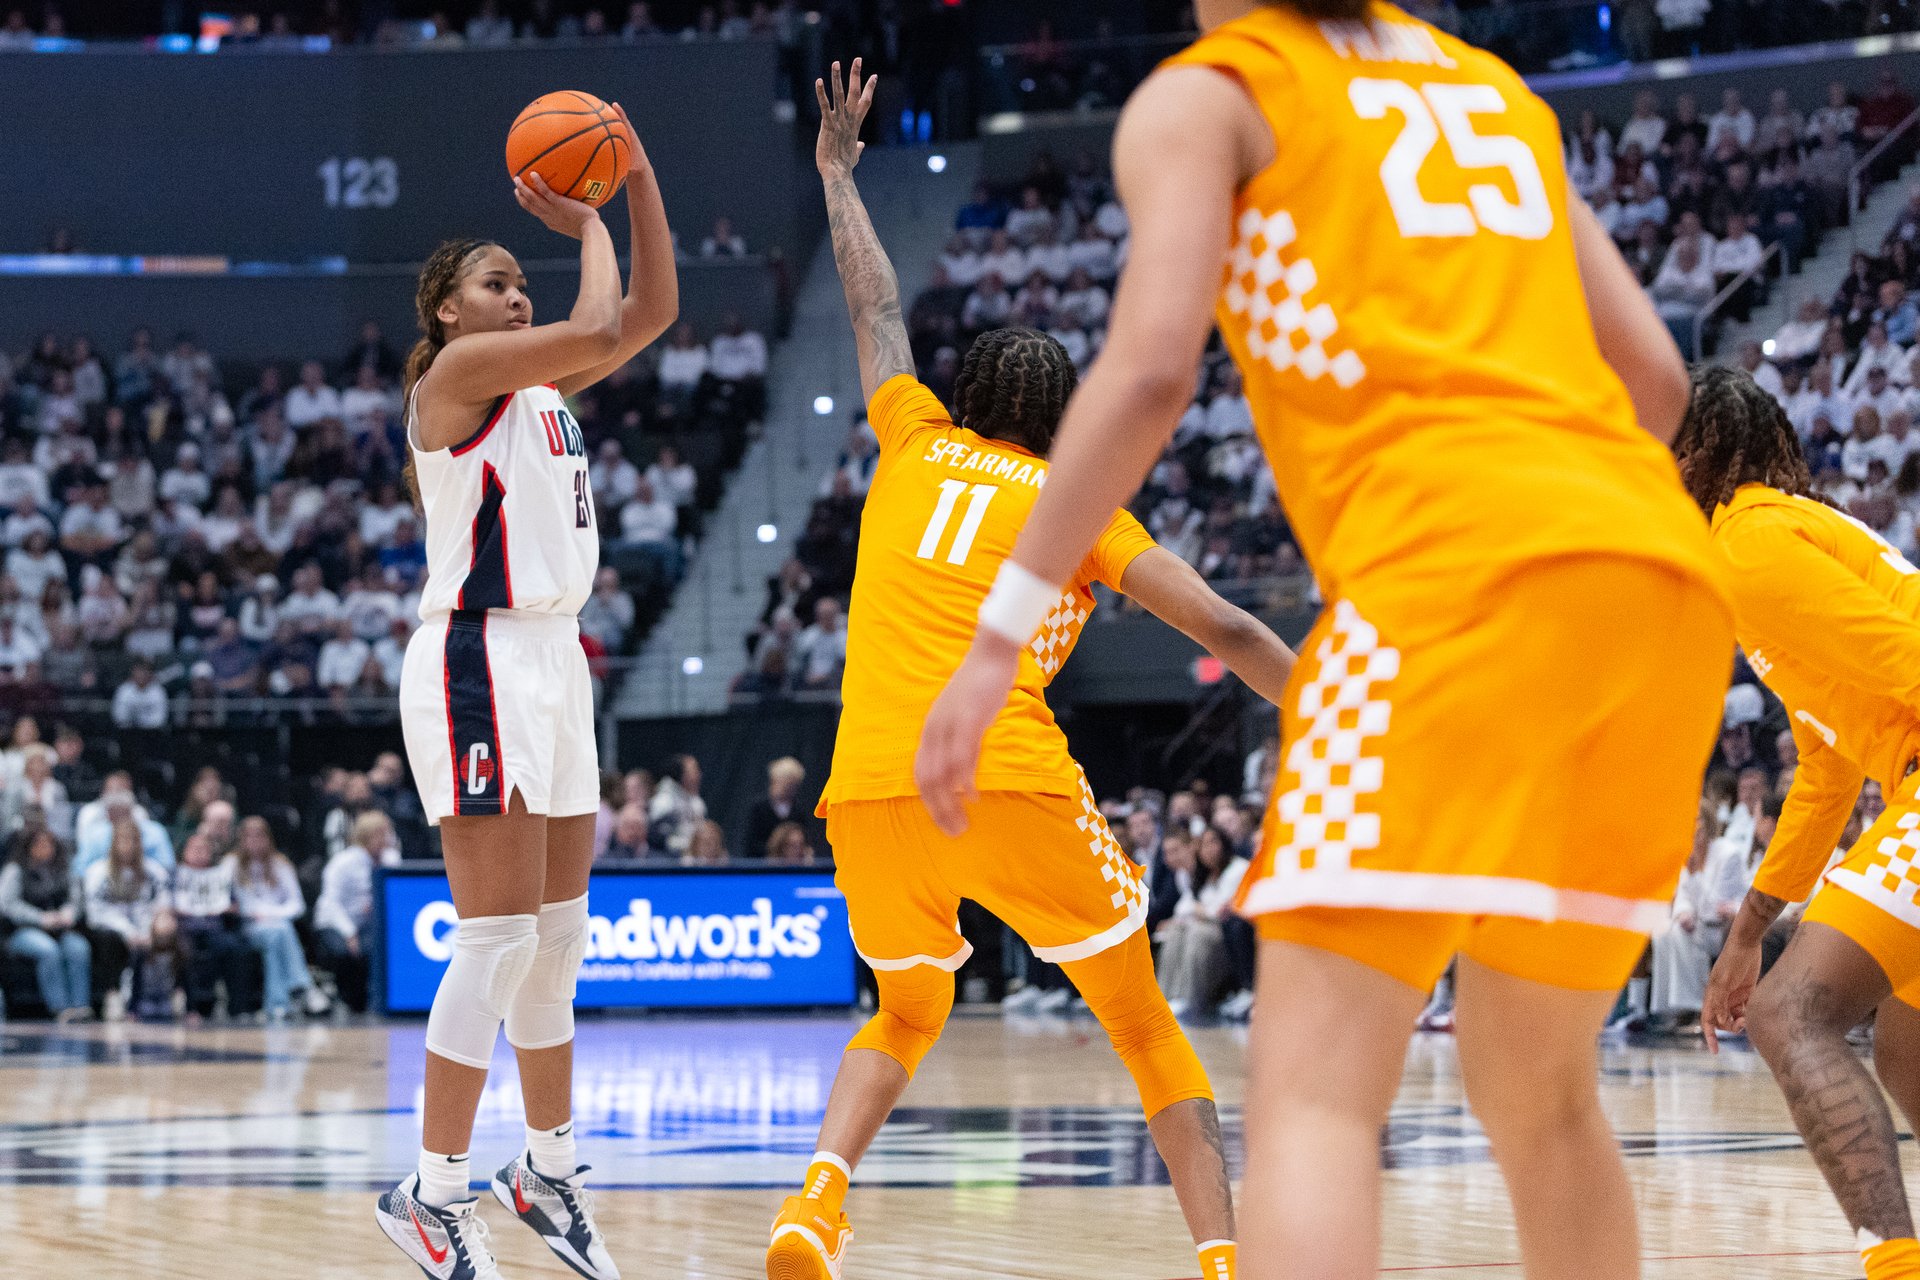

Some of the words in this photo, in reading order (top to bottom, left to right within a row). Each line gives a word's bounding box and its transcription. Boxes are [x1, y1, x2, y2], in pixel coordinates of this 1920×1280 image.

[319, 157, 399, 207] 123
[1348, 77, 1553, 240] 25
[923, 438, 1048, 489] SPEARMAN
[916, 478, 999, 566] 11
[413, 897, 822, 962] Gndworks
